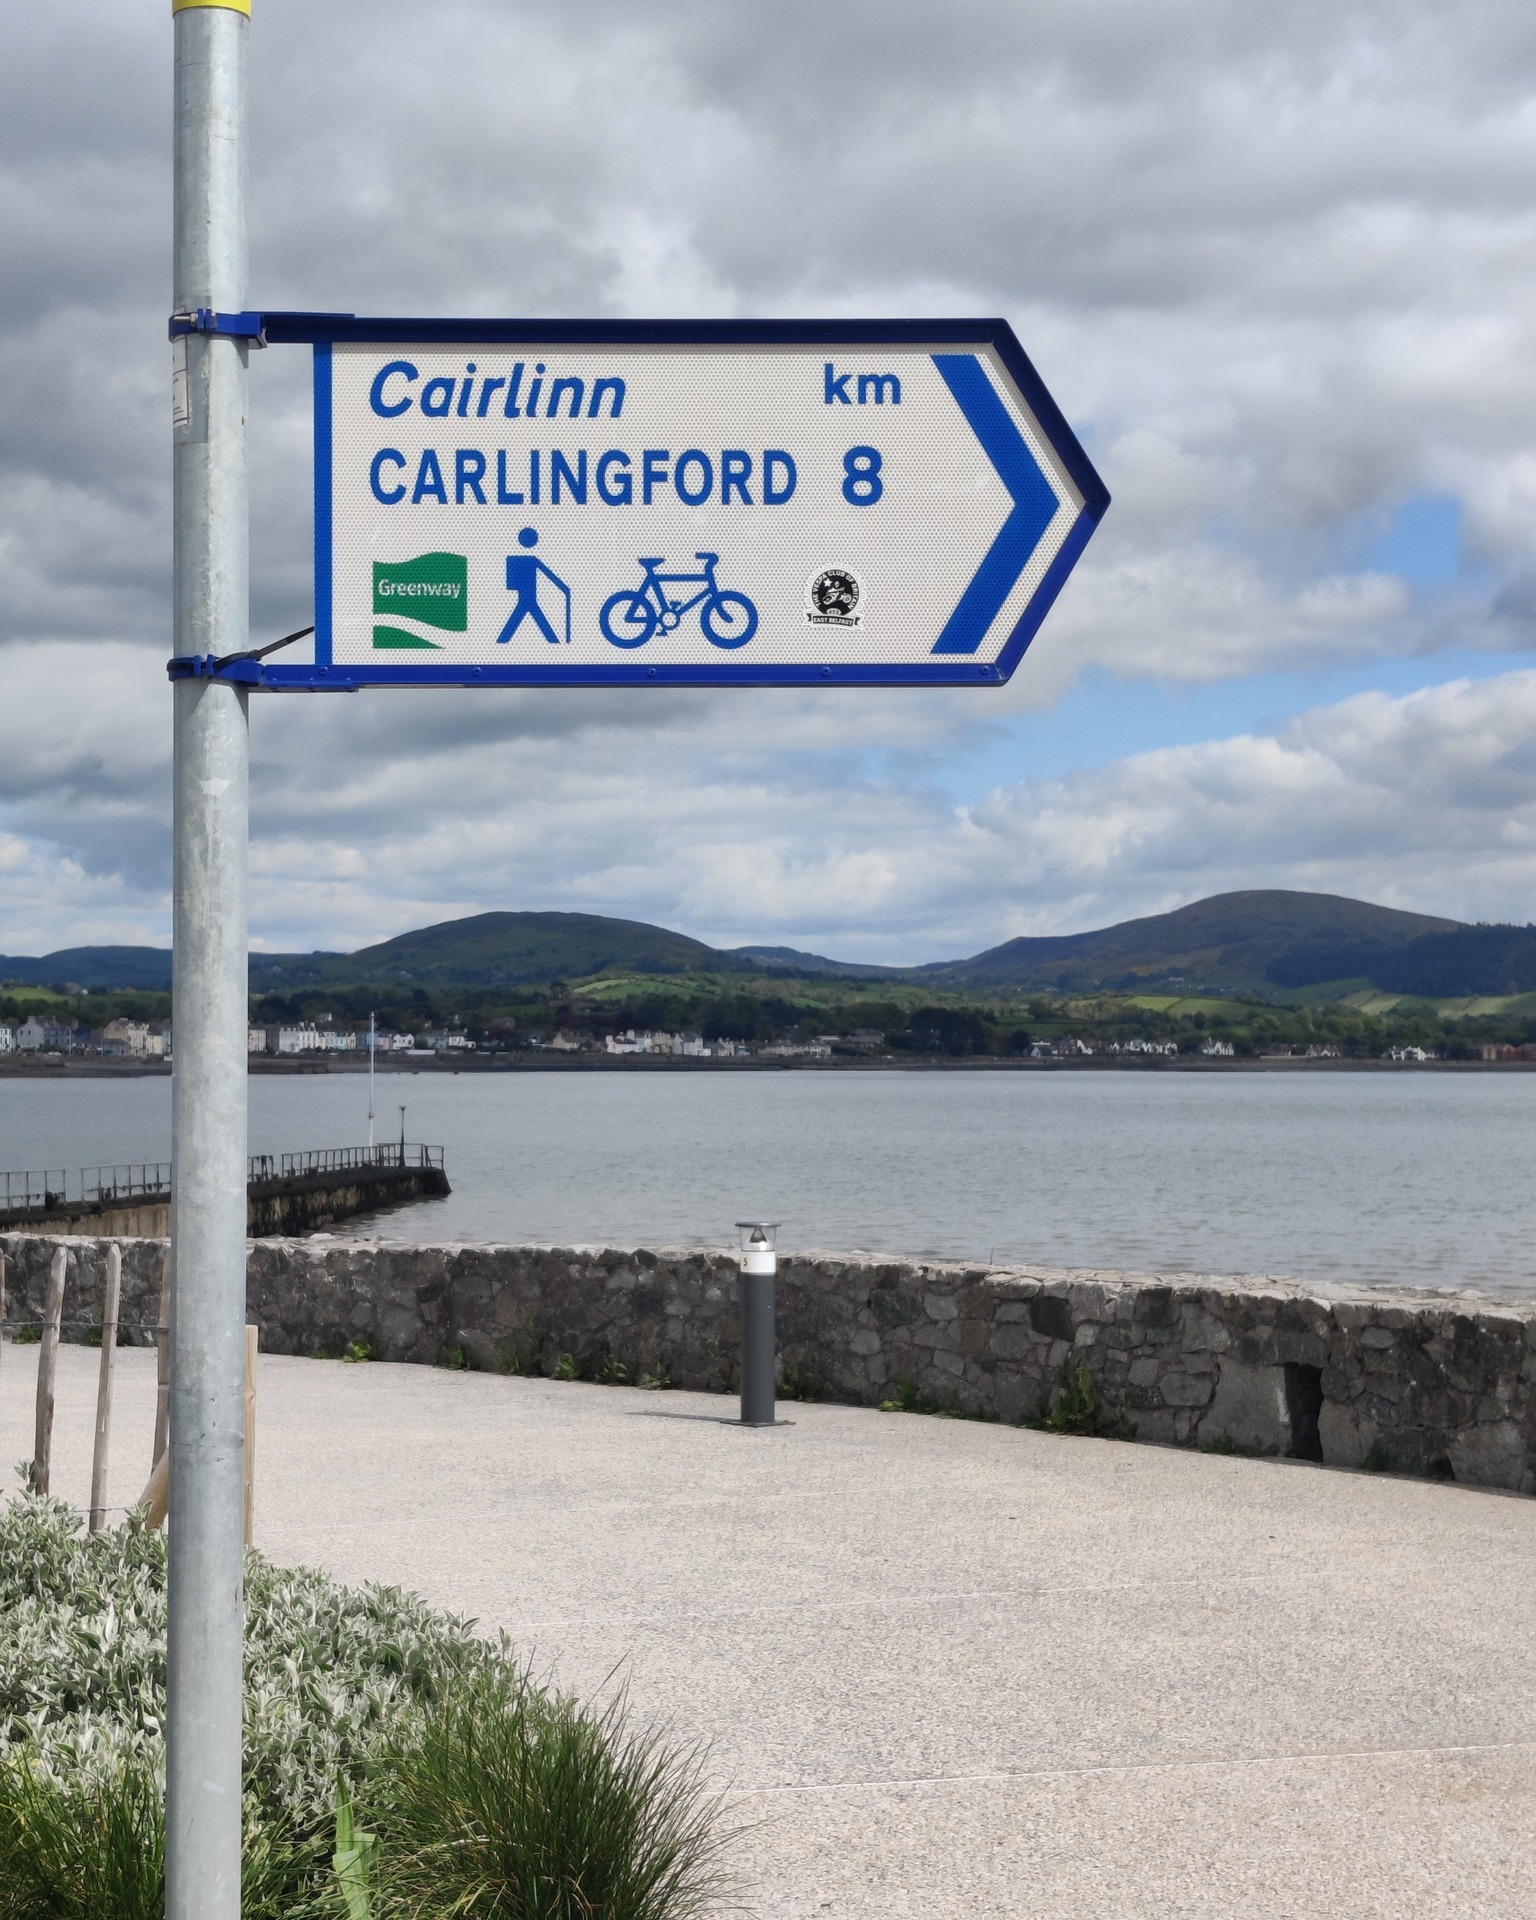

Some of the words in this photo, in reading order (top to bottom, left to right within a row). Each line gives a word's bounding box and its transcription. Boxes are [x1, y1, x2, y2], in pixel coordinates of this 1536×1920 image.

[369, 360, 627, 418] Cairlinn
[824, 363, 902, 404] km
[369, 448, 798, 506] CARLINGFORD
[842, 446, 883, 506] 8
[378, 579, 461, 599] Greenway
[813, 573, 828, 593] VESPA
[848, 583, 859, 609] BRITAIN
[828, 617, 853, 625] BELFAST
